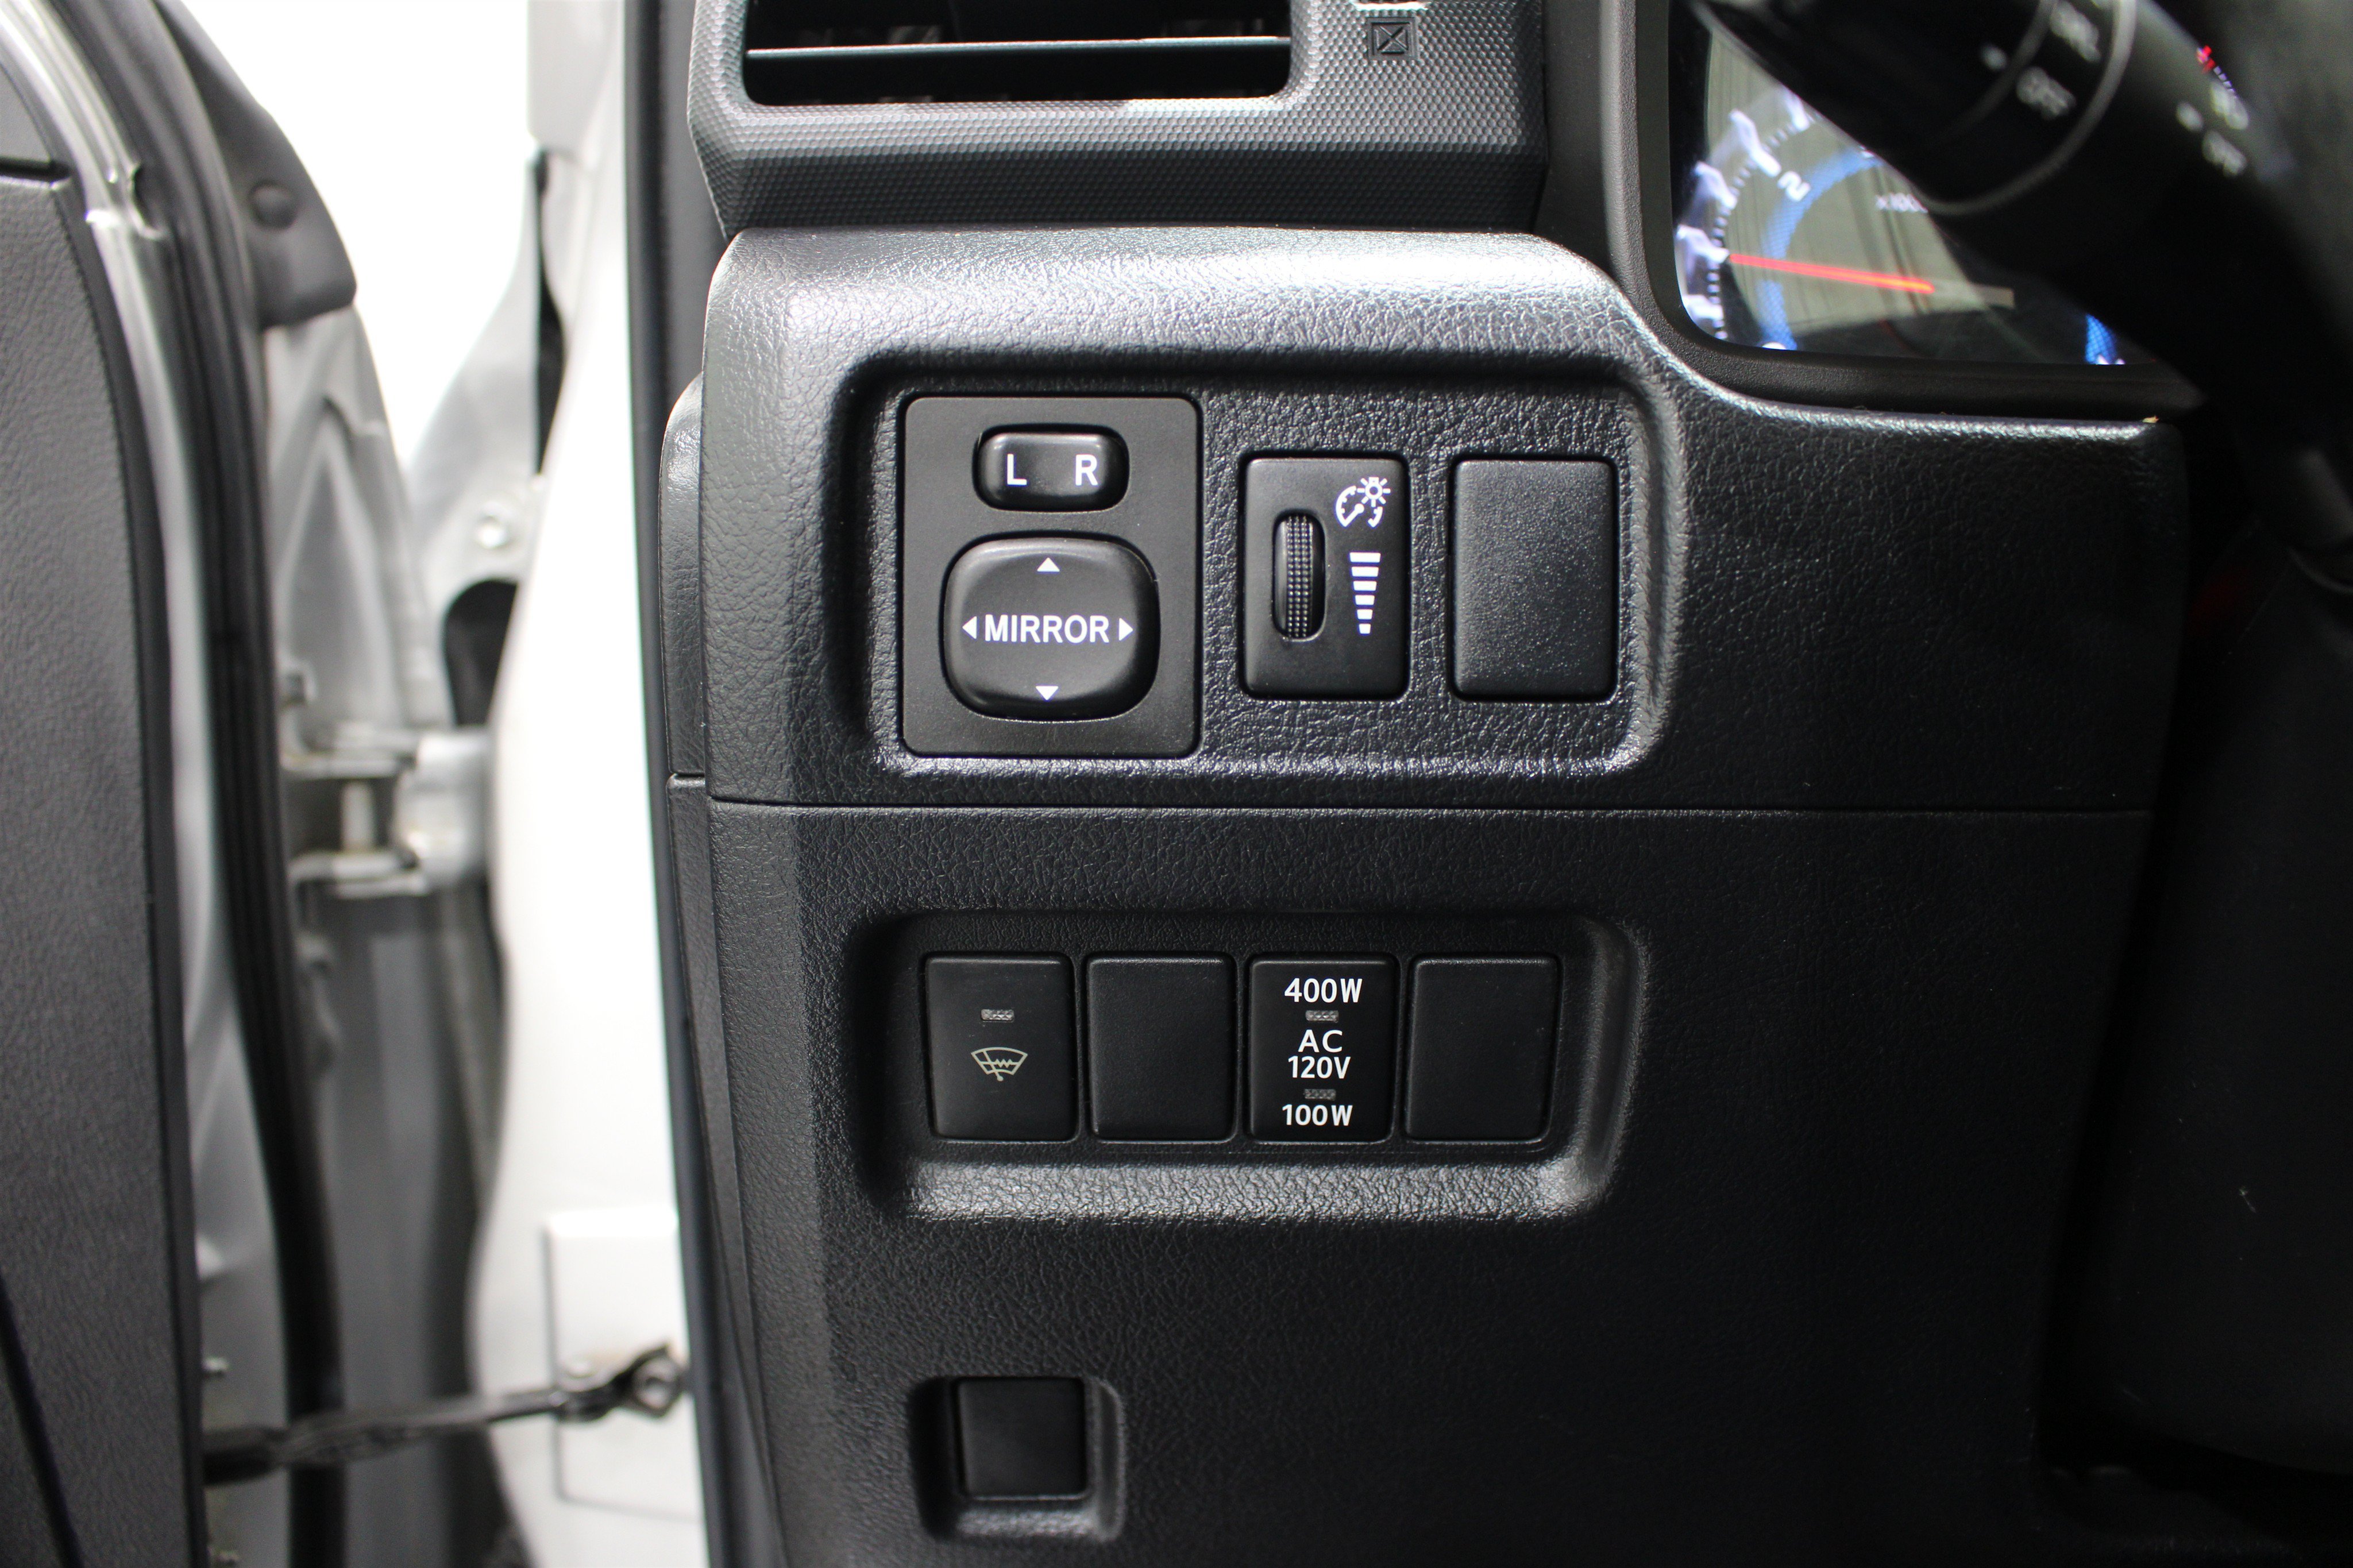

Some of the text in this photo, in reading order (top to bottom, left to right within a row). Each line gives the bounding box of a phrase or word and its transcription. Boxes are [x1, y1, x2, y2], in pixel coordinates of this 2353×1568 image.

[1777, 171, 1811, 201] 2
[1006, 454, 1098, 486] L R
[984, 614, 1110, 644] MIRROR
[1284, 978, 1363, 1003] 400W
[1298, 1029, 1343, 1053] AC
[1288, 1056, 1351, 1079] 120V
[1282, 1104, 1353, 1126] 100W
